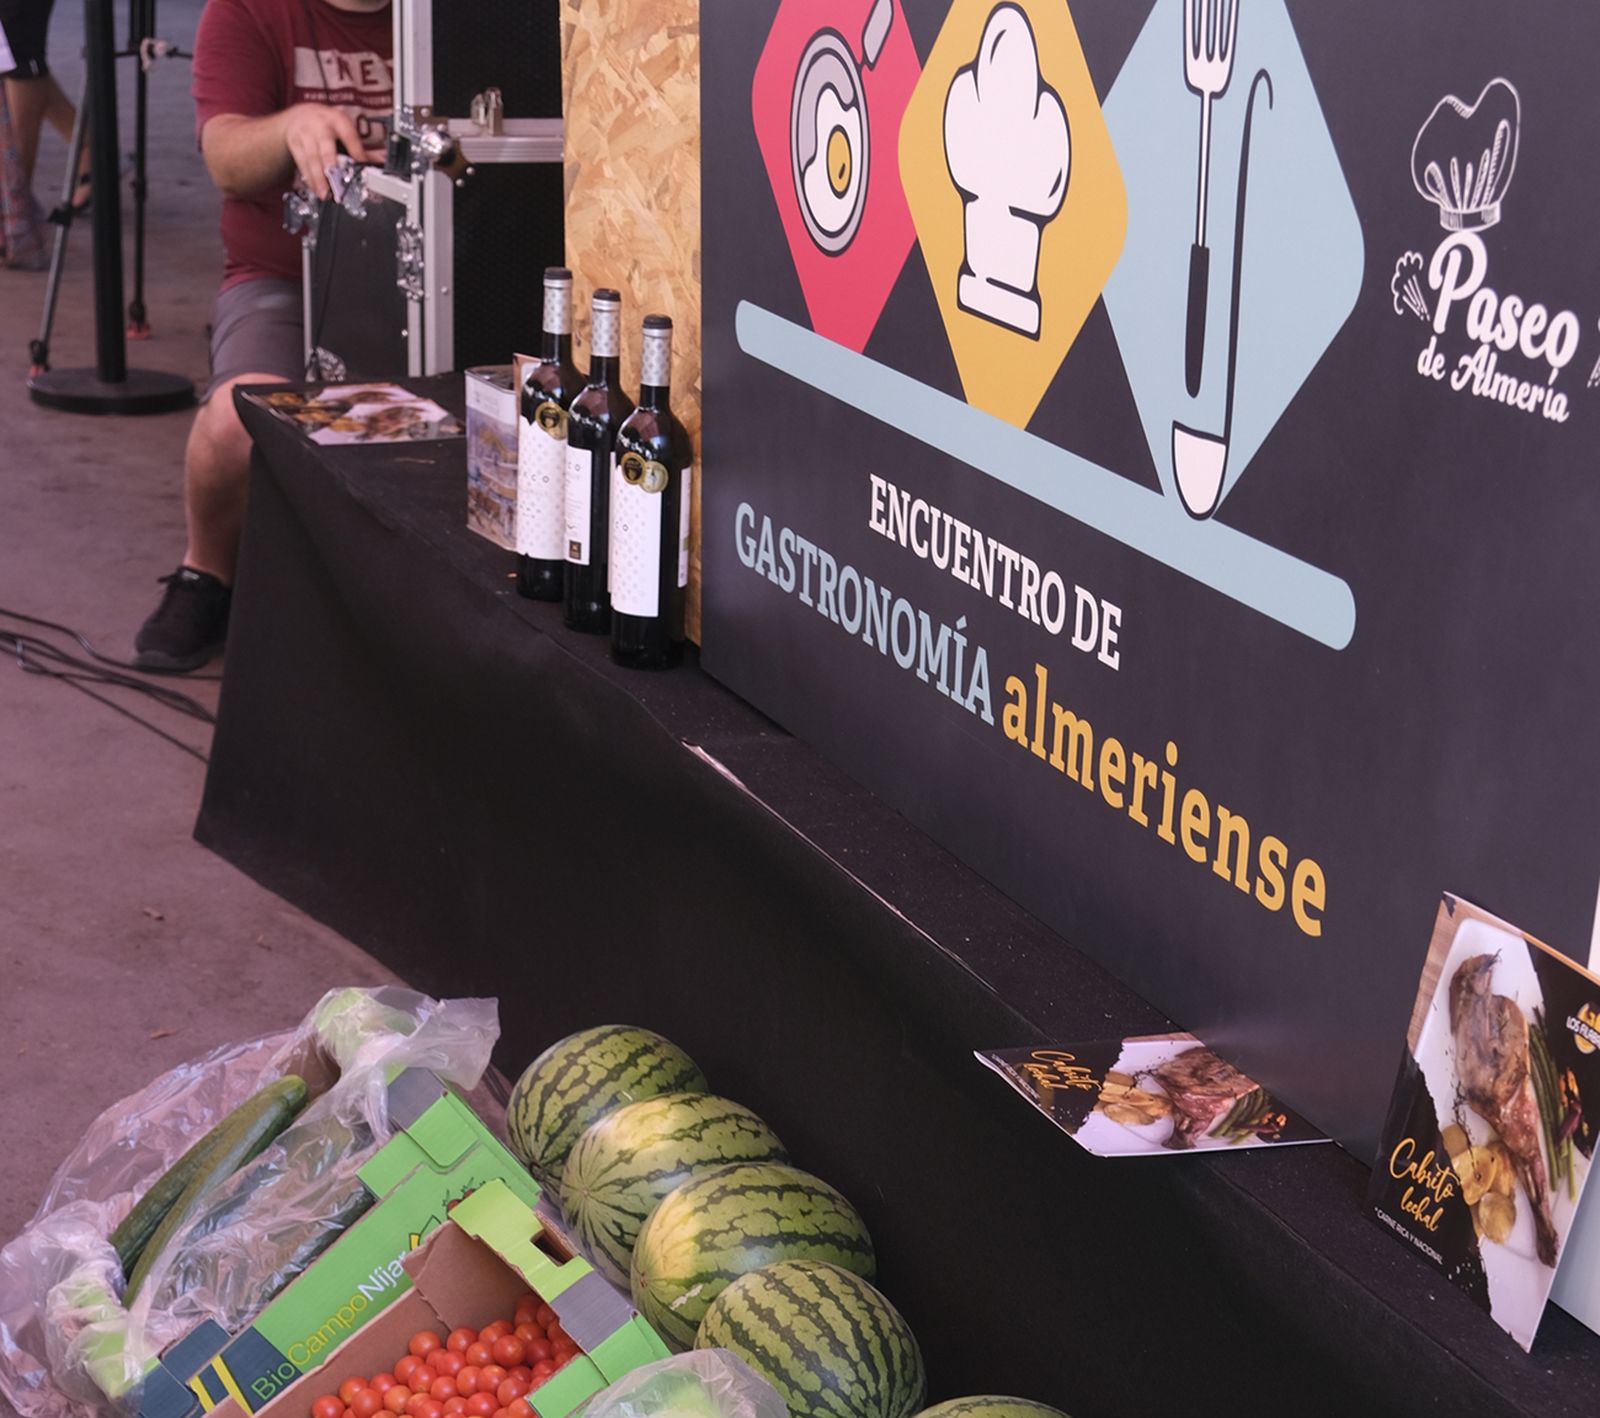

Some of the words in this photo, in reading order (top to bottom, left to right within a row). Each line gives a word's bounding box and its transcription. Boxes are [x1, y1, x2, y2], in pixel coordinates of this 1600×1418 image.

[1428, 231, 1580, 368] Paseo
[1417, 335, 1446, 381] de
[1450, 344, 1570, 423] Almería
[869, 473, 1066, 635] ENCUENTRO
[1071, 584, 1122, 671] DE
[735, 502, 995, 726] GASTRONOMÍA
[1002, 662, 1327, 937] almeriense
[1389, 1137, 1461, 1203] Cabrito
[1401, 1185, 1444, 1232] lechal
